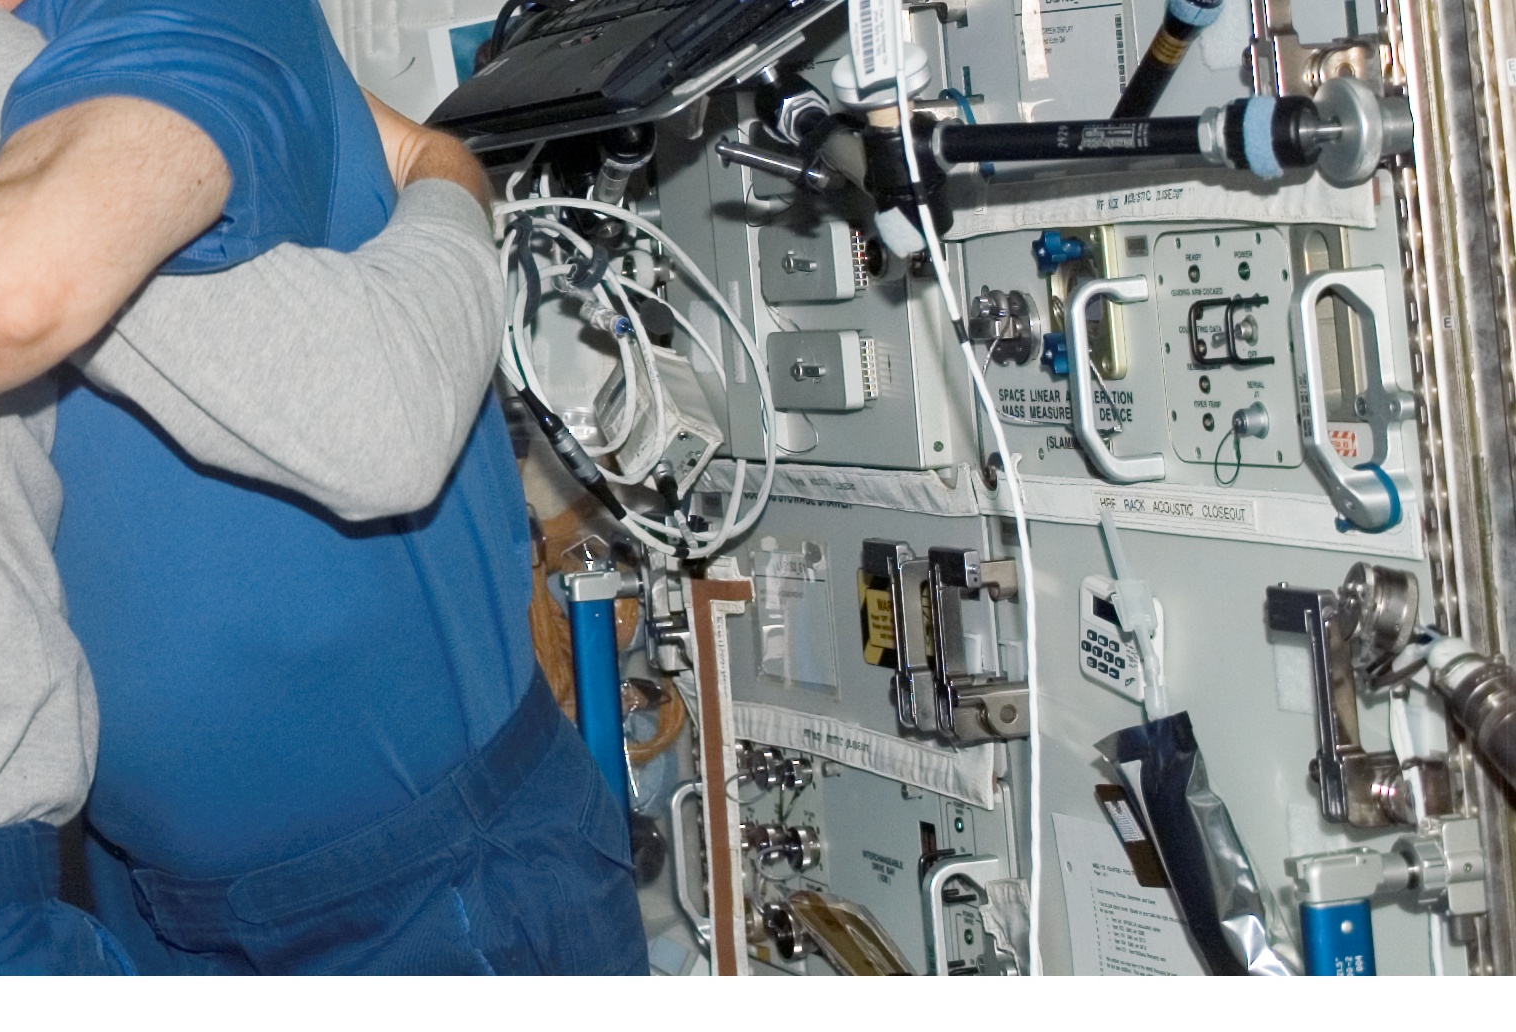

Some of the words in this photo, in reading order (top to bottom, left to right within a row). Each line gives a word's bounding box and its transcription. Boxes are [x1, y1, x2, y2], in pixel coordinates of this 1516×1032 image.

[1443, 318, 1452, 329] E
[998, 388, 1026, 402] SPACE
[1029, 389, 1061, 403] LINEAR
[1002, 405, 1026, 418] MASS
[1123, 498, 1146, 512] RACK
[1152, 500, 1194, 517] ACOUSTIC
[1201, 504, 1246, 522] CLOSEOUT
